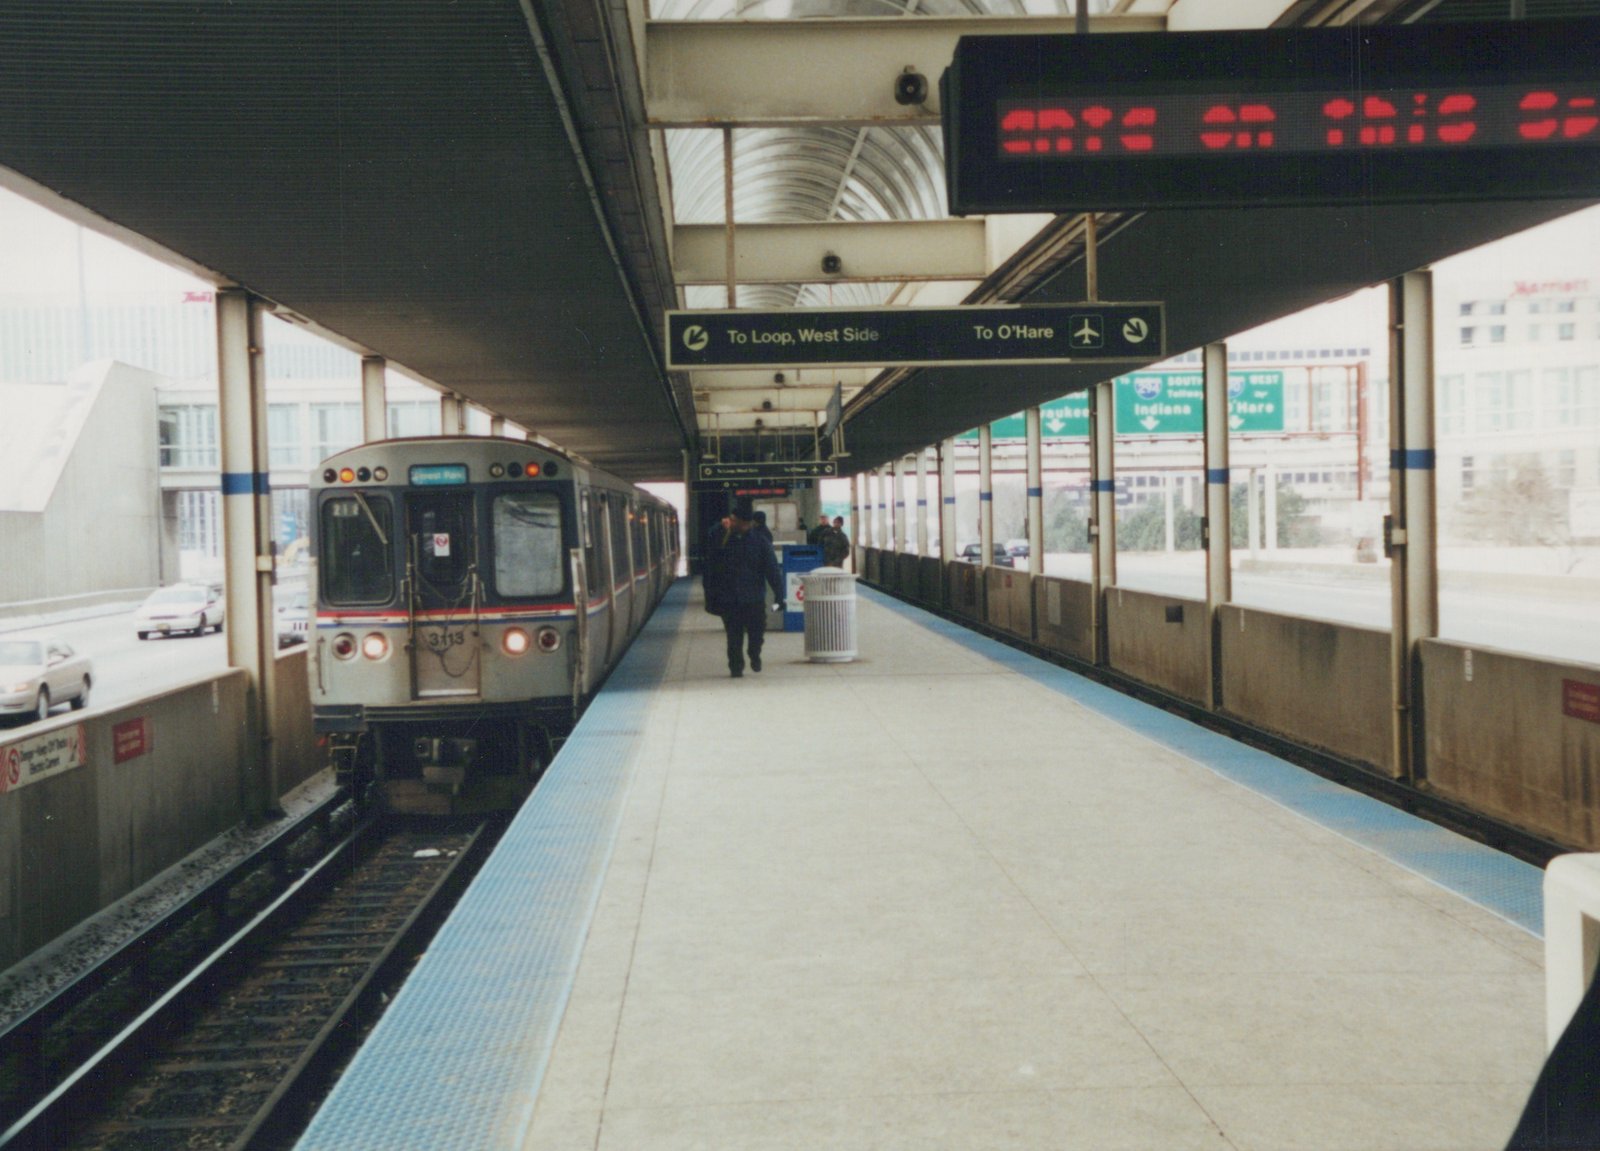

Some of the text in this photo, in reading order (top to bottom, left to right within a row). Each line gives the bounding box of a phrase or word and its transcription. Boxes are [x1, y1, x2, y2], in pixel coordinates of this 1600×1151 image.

[727, 325, 881, 347] To Loop, West Side
[973, 323, 1055, 340] To O'Hare
[1249, 374, 1280, 385] WEST
[1134, 403, 1192, 416] Indiana
